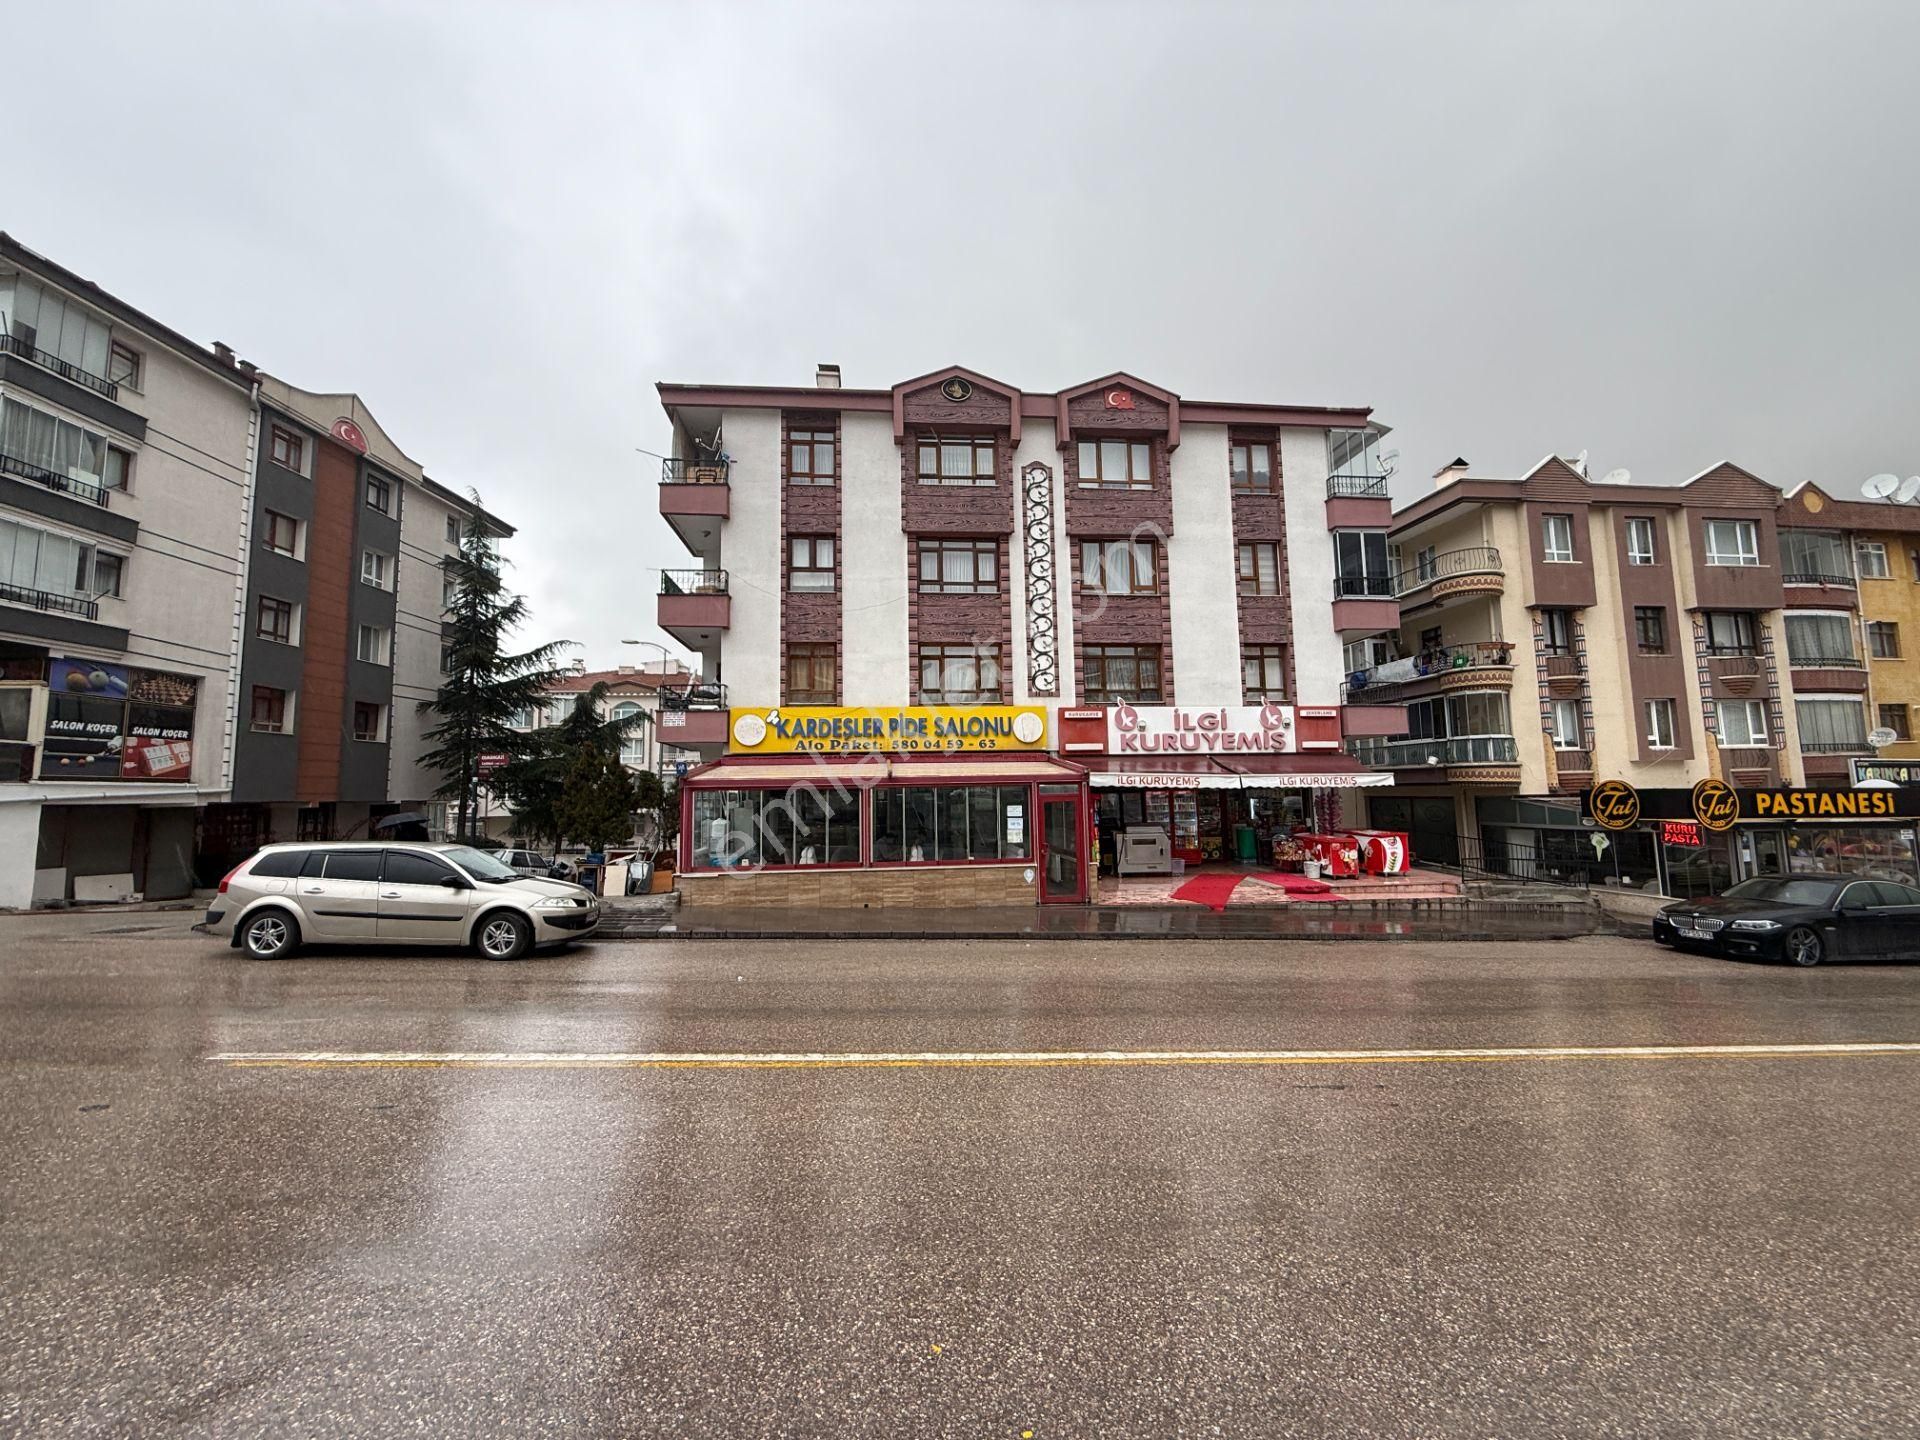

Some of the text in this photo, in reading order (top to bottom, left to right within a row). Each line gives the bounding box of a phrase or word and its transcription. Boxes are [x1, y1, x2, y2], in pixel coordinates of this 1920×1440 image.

[50, 720, 118, 734] SALON KOÇER
[776, 713, 1012, 740] KARDEŞLER PİDE SALONU
[1174, 708, 1228, 731] İLGİ
[131, 726, 189, 739] SALON KOÇER
[795, 740, 825, 750] Alo
[829, 739, 883, 751] Paket:
[892, 739, 919, 750] 580
[923, 739, 941, 749] 04
[947, 739, 964, 749] 59
[979, 739, 996, 749] 63
[1120, 731, 1287, 752] KURUYEMİŞ
[1857, 767, 1909, 782] KARINCA
[1597, 790, 1635, 817] Tat
[1699, 789, 1735, 817] Tat
[1665, 823, 1697, 834] KURU
[1664, 833, 1700, 845] PASTA
